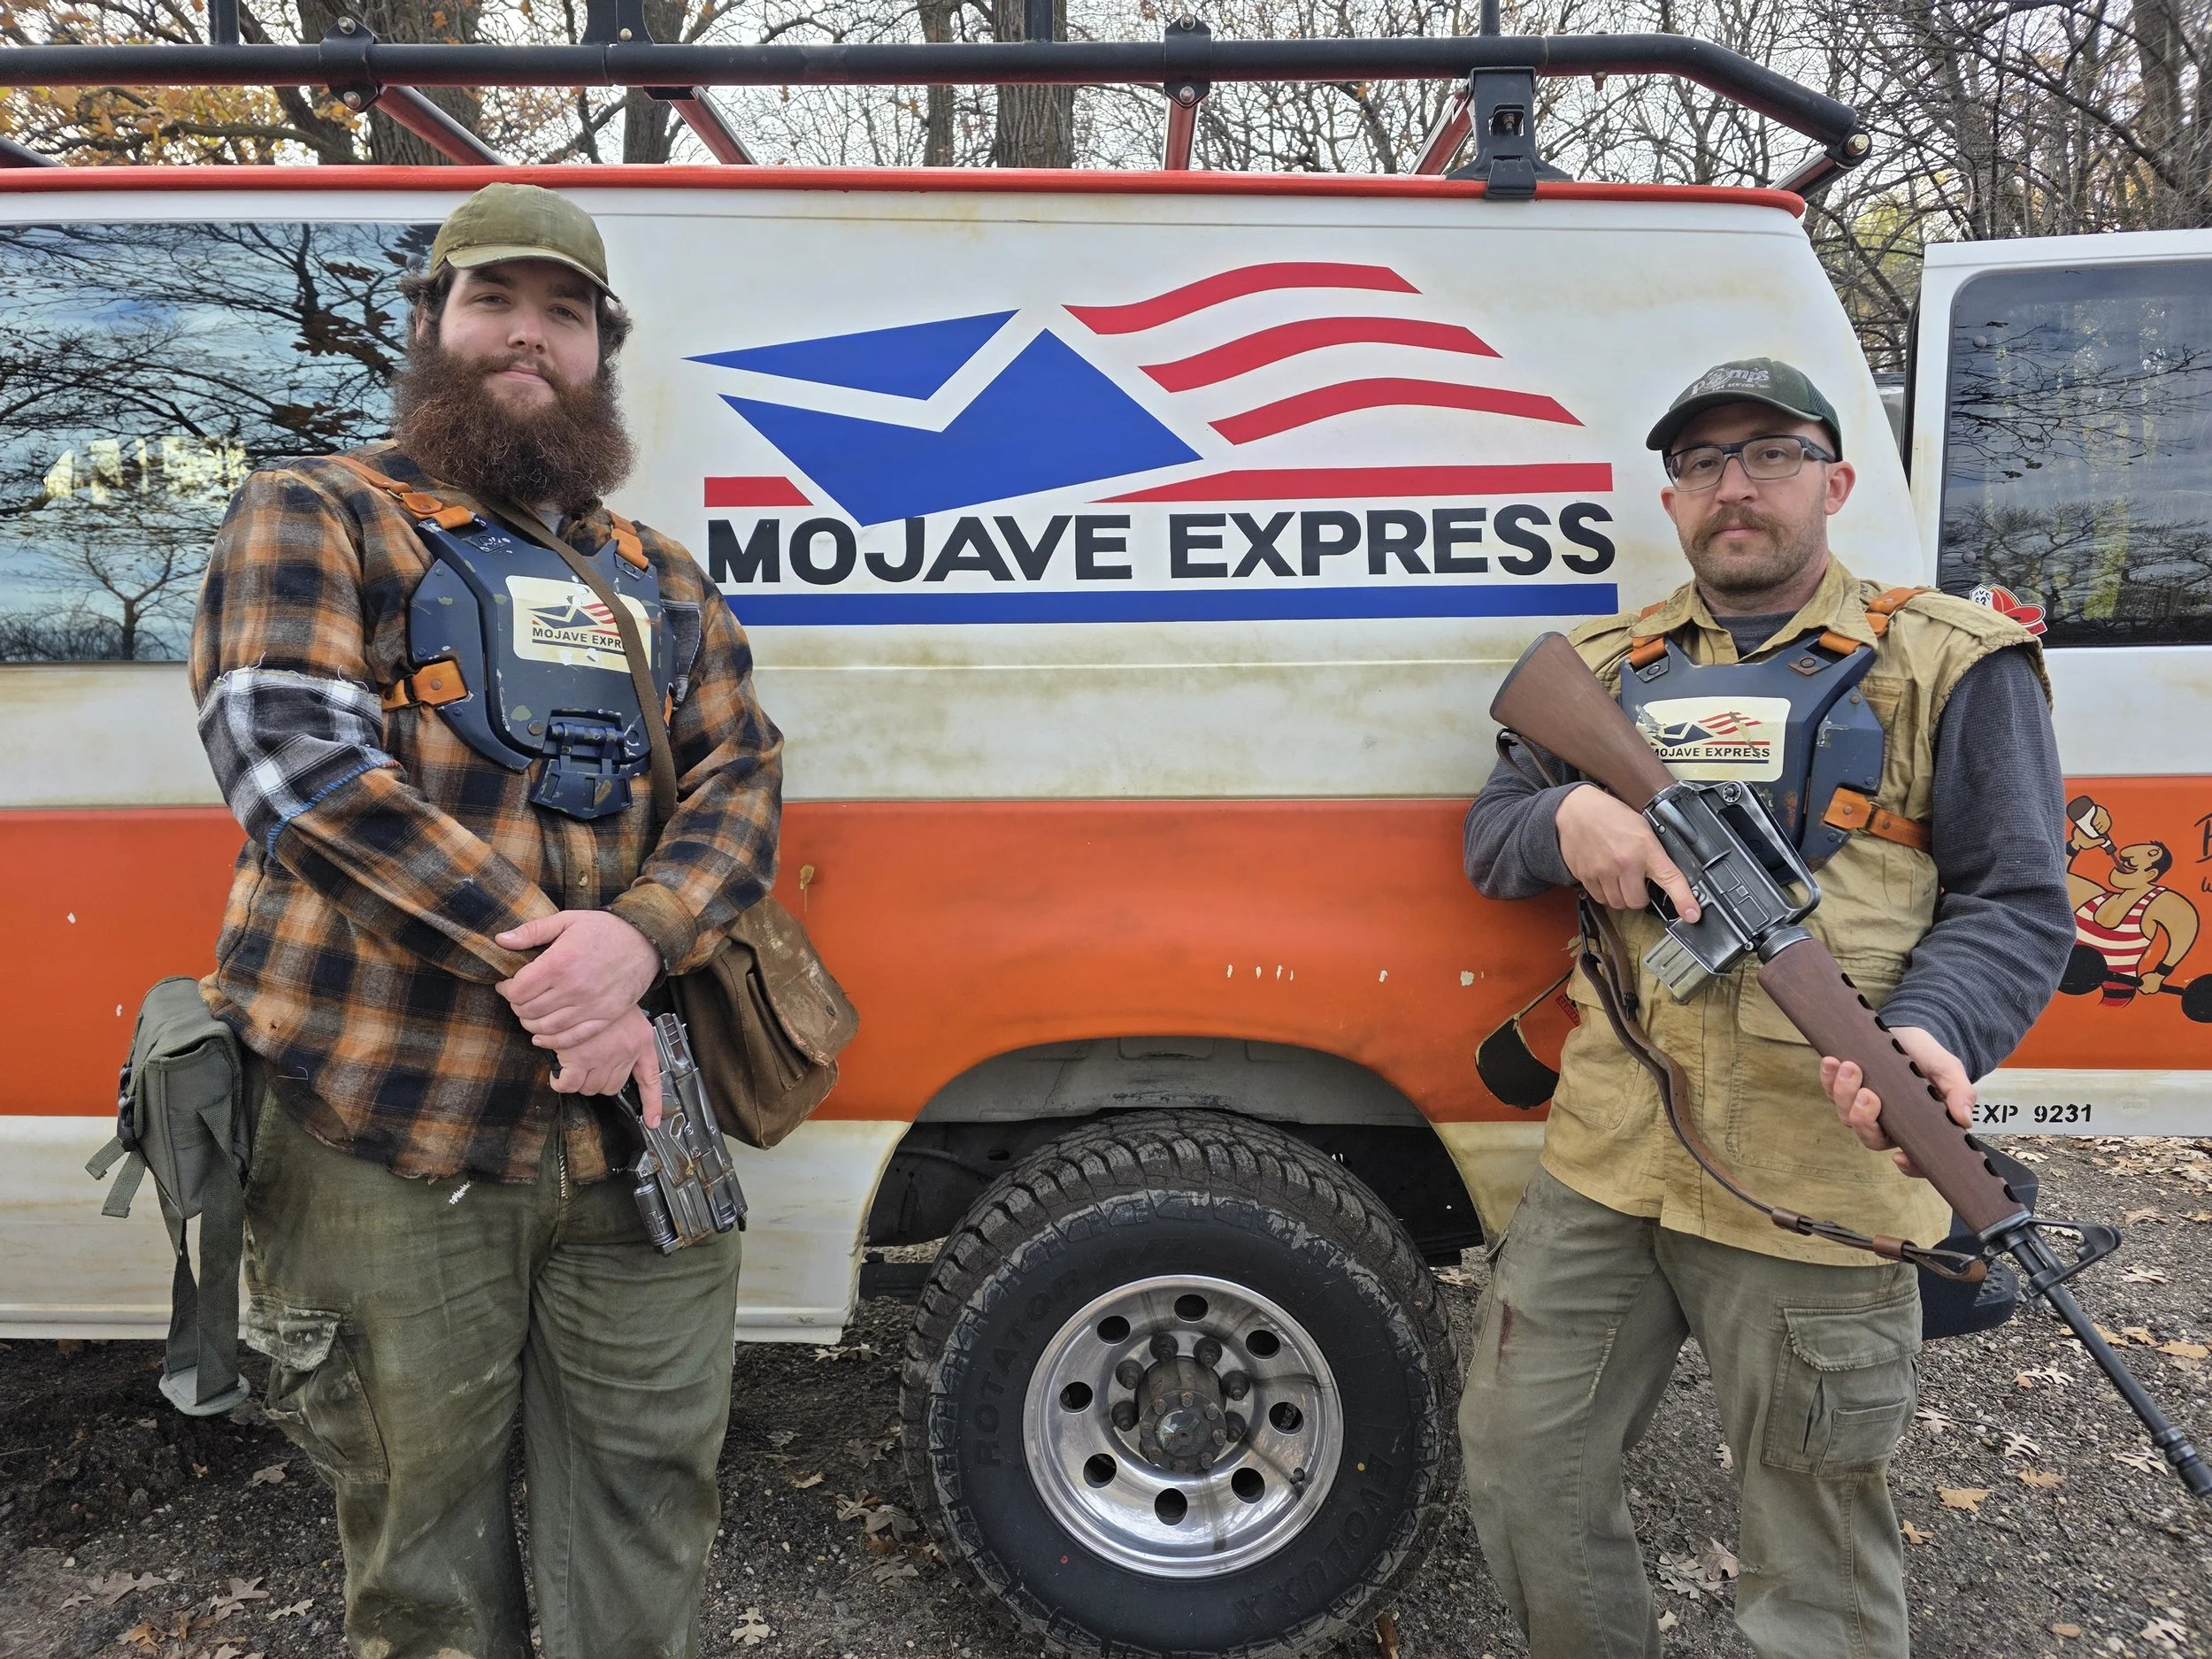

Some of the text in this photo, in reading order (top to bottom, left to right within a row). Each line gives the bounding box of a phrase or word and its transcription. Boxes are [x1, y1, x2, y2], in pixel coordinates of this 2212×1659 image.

[709, 503, 1617, 584] MOJAVE EXPRESS
[533, 626, 625, 649] MOJAVE EXPR
[1705, 748, 1770, 757] EXPRESS
[2034, 1103, 2093, 1124] 9231
[973, 1267, 1082, 1467] ROTATOR
